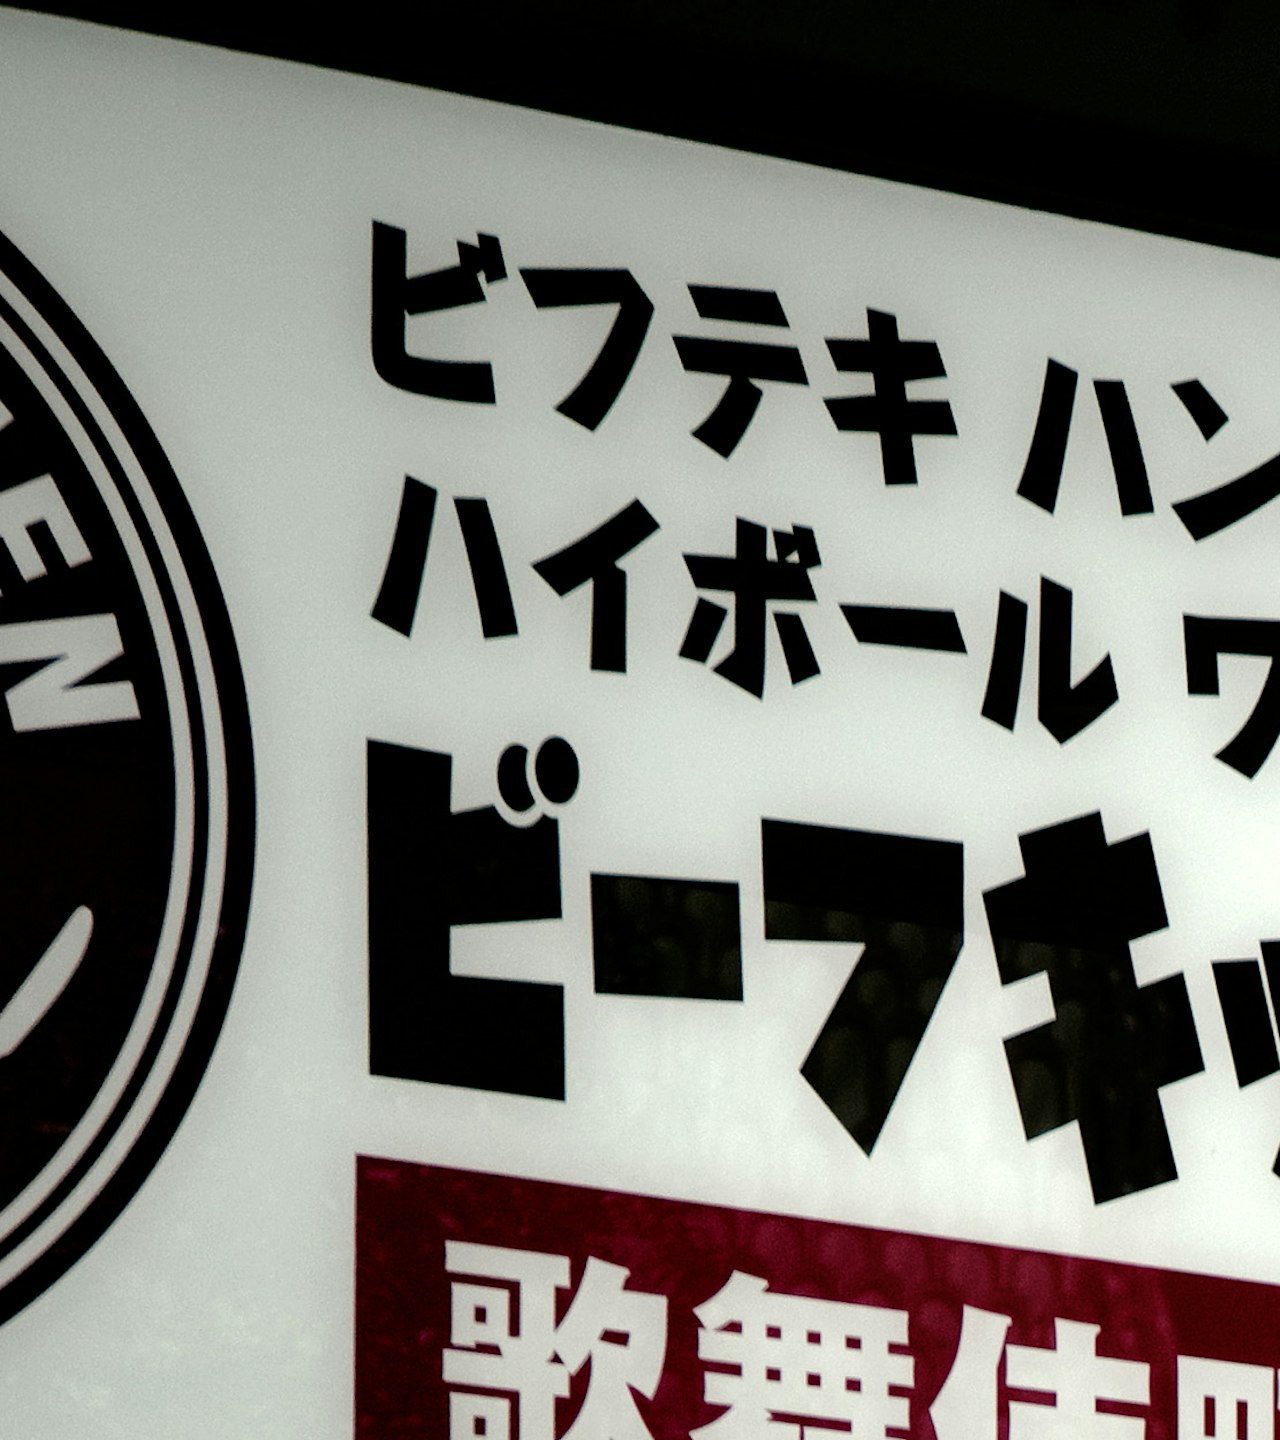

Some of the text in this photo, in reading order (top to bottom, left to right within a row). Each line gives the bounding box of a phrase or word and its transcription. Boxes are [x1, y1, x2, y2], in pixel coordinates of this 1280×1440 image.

[371, 220, 957, 485] ビフテキ
[0, 440, 141, 733] EN
[371, 476, 1118, 744] ハイボール
